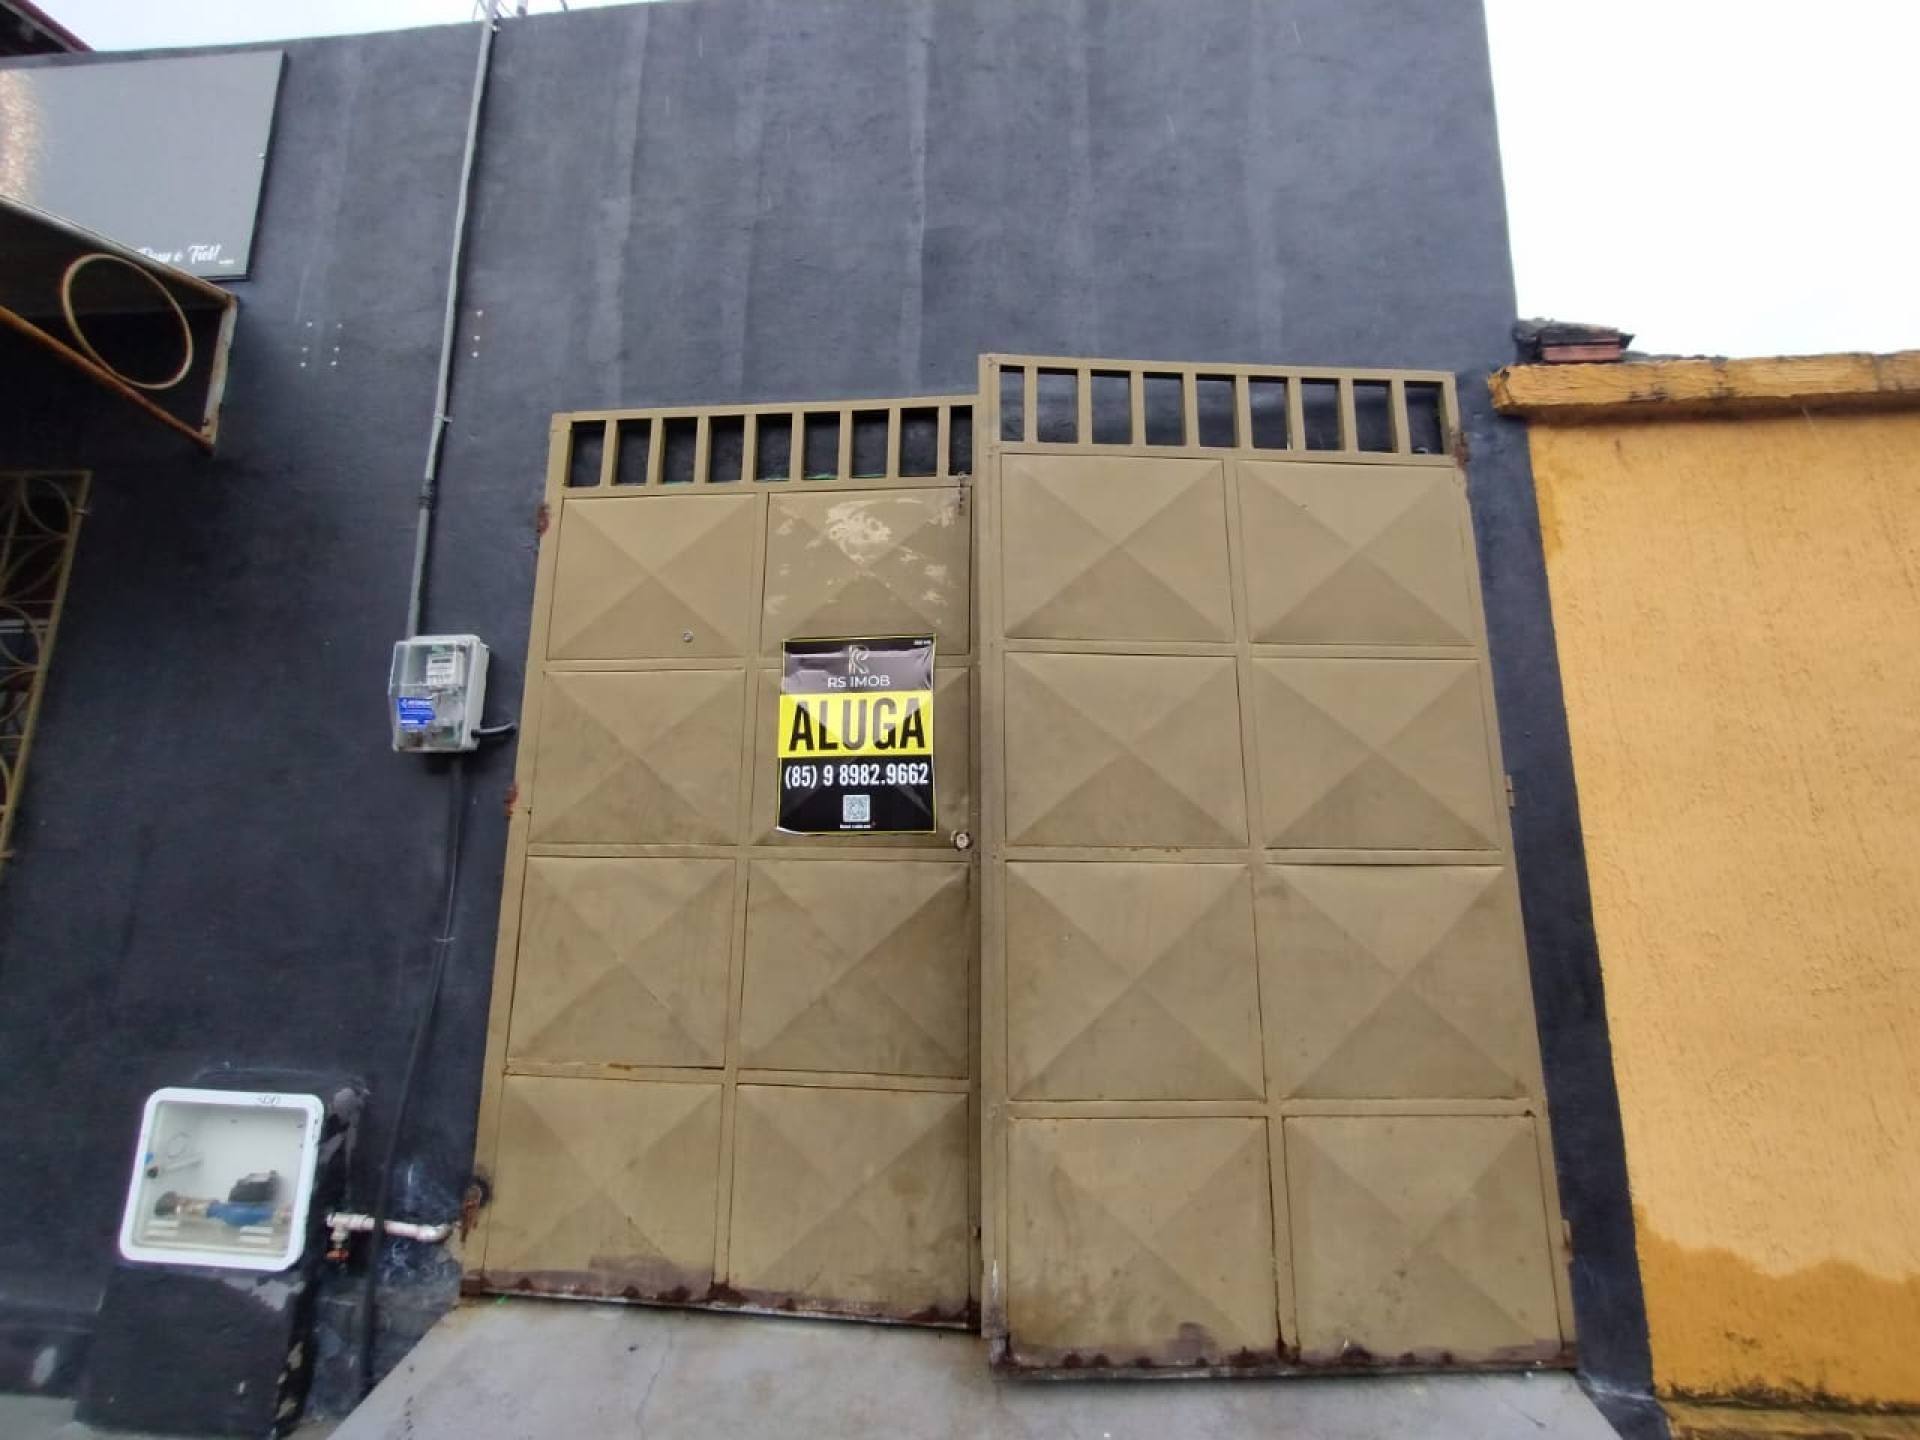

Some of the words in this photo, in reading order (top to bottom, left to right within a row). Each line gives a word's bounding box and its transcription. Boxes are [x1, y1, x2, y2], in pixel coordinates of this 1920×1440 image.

[827, 677, 847, 688] RS
[850, 675, 891, 688] IMOB
[788, 698, 926, 751] ALUGA
[785, 766, 817, 789] (85)
[823, 765, 834, 786] 9
[839, 763, 929, 786] 8982.9662
